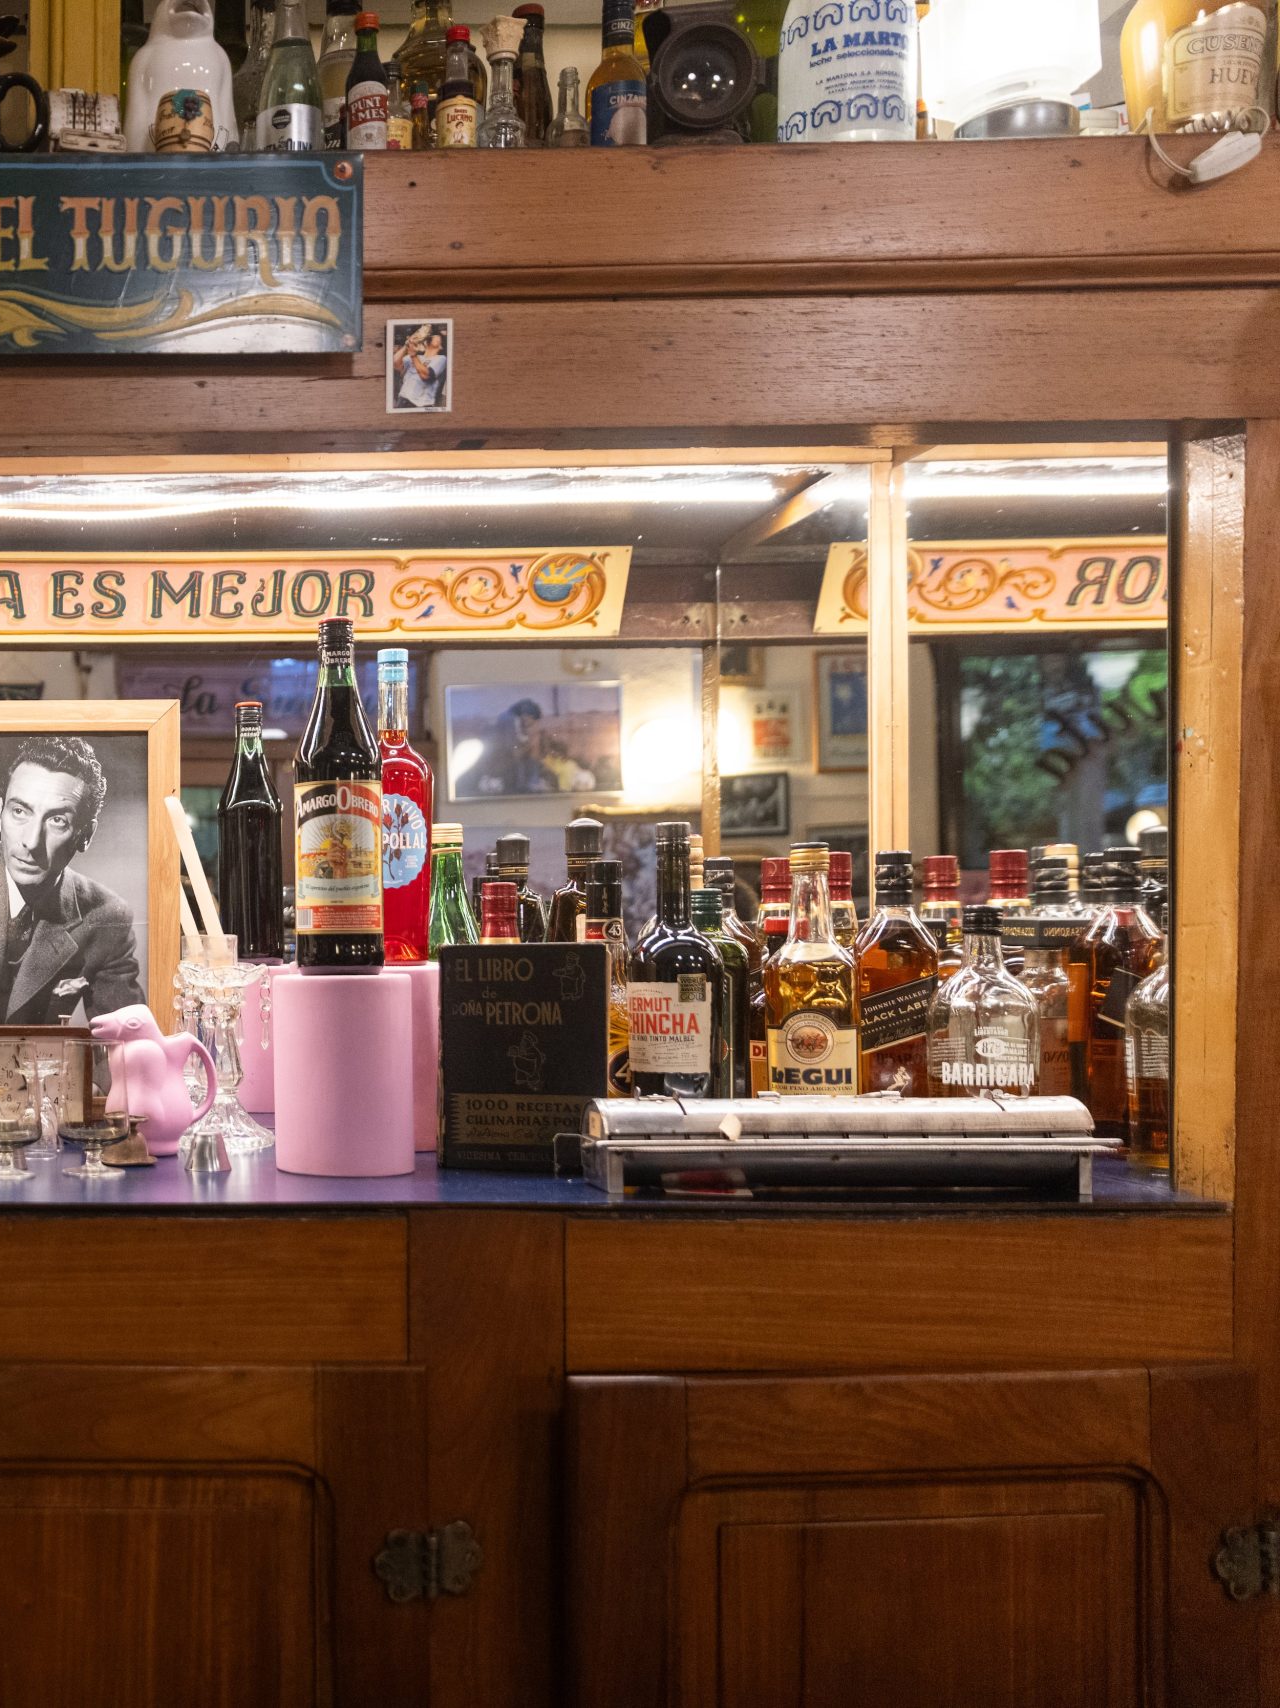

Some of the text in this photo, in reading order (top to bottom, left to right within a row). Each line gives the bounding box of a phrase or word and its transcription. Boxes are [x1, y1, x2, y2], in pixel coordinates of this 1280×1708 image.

[811, 37, 837, 57] LA
[809, 56, 832, 69] leche
[1209, 67, 1260, 85] HUEV
[351, 96, 381, 112] PUNT
[358, 107, 386, 121] MES
[447, 113, 473, 124] LUCANO
[59, 194, 342, 287] TUGURIO
[50, 569, 127, 620] ES
[150, 568, 375, 620] MEJOR
[296, 784, 379, 823] AMARGO OBRERO
[608, 925, 622, 936] 43
[455, 958, 534, 982] EL LIBRO
[482, 986, 497, 999] de
[486, 1002, 562, 1026] PETRONA
[864, 999, 895, 1015] JOHNNIE
[899, 999, 928, 1014] LABE
[771, 1067, 852, 1085] LEGUI
[942, 1062, 1035, 1086] BARRICADA
[467, 1100, 582, 1114] 1000 RECETAS
[466, 1114, 550, 1126] CULINARIAS
